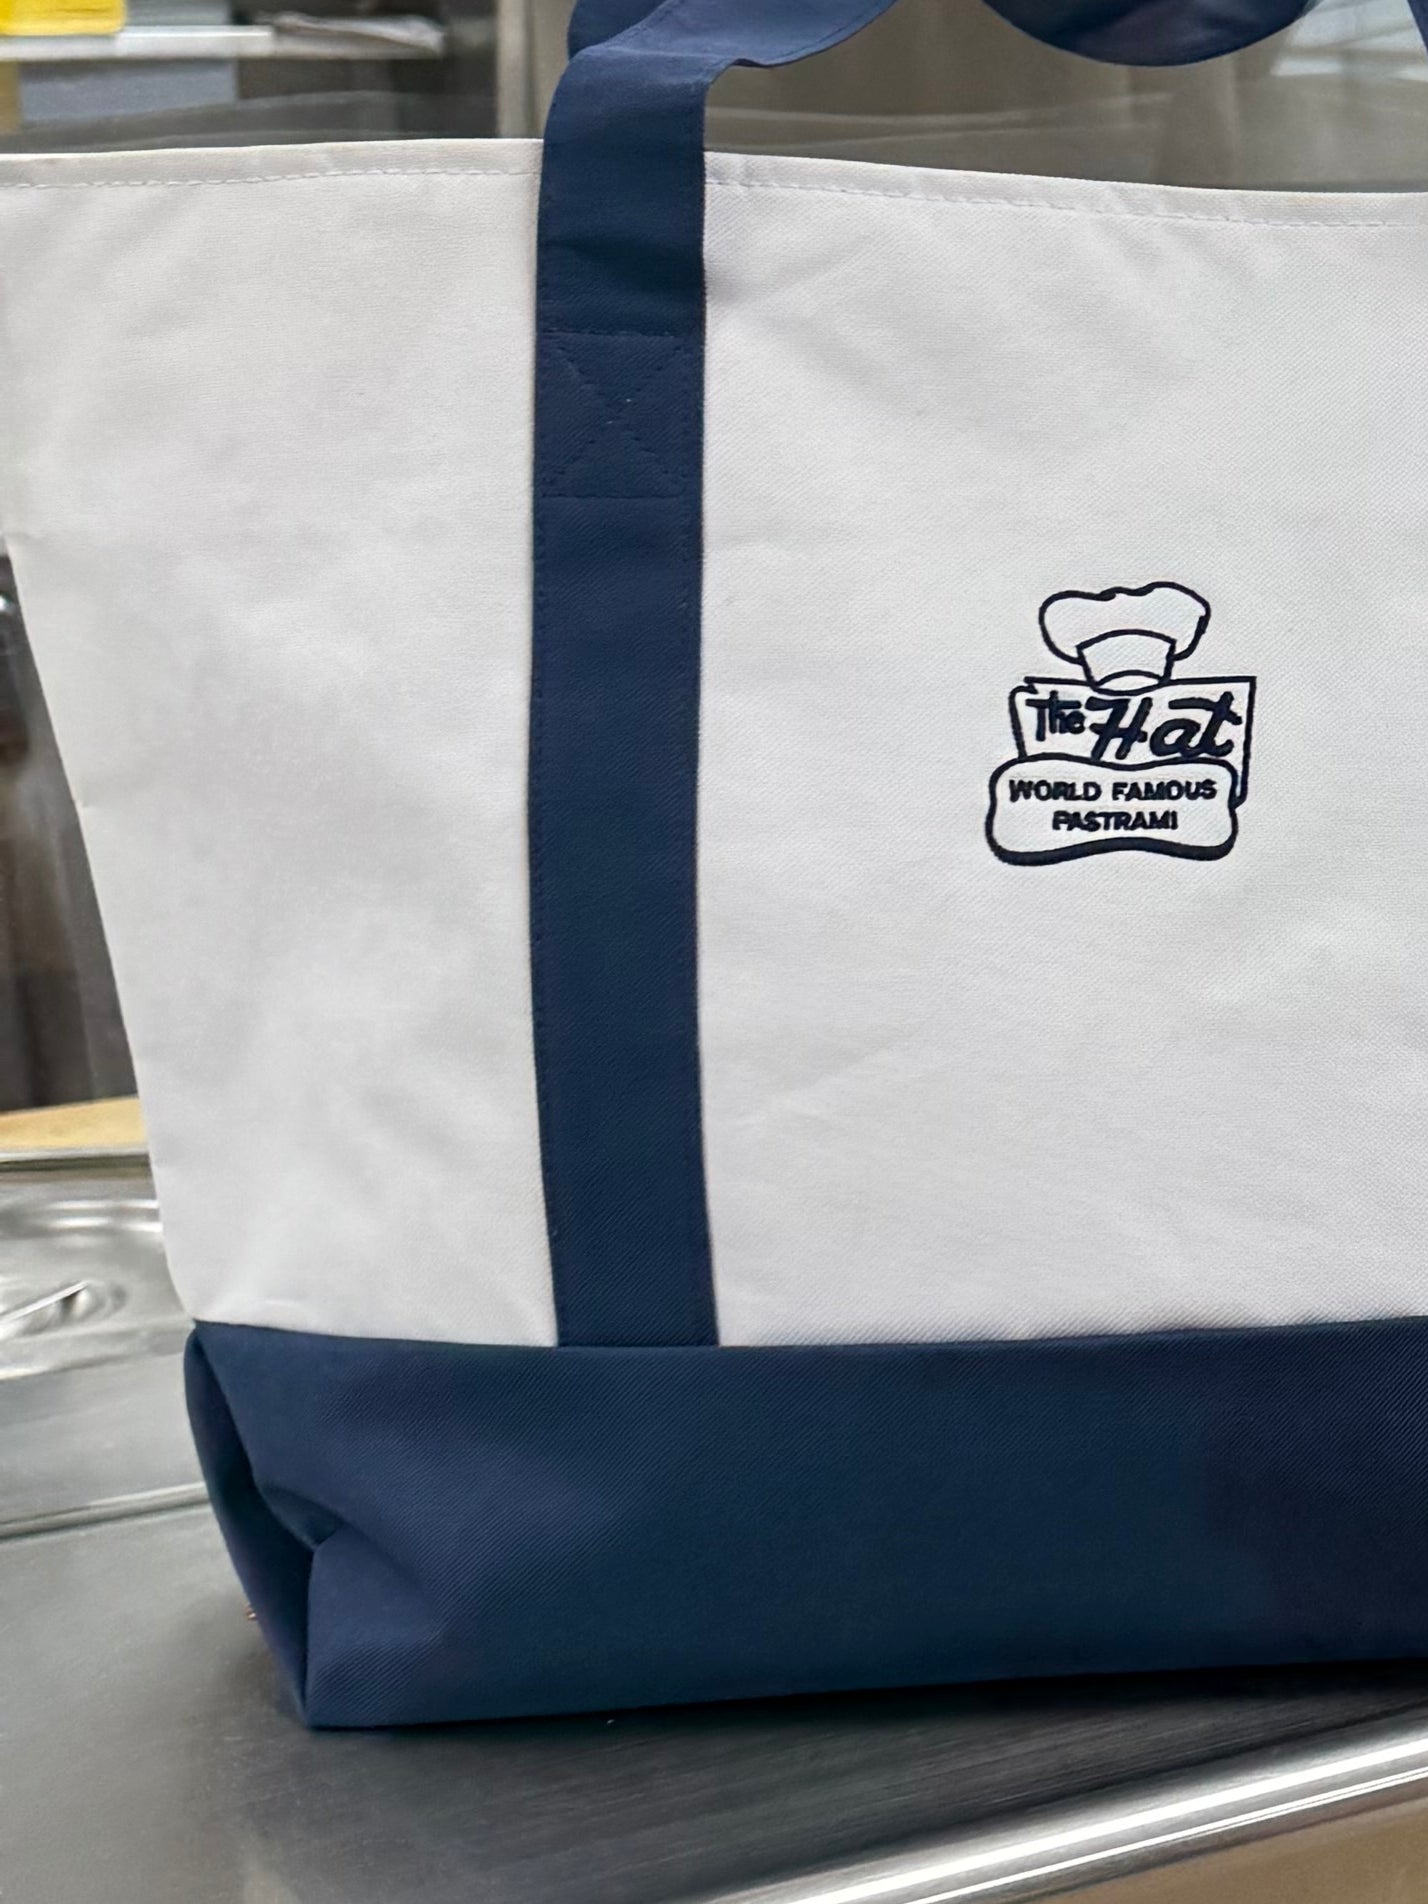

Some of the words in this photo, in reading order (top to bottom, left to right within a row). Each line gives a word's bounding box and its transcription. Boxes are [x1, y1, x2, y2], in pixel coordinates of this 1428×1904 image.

[1025, 690, 1086, 741] The
[1084, 692, 1242, 760] Hat
[1009, 778, 1102, 802] WORLD
[1112, 778, 1218, 801] FAMOUS
[1052, 810, 1179, 832] PASTRAMI
